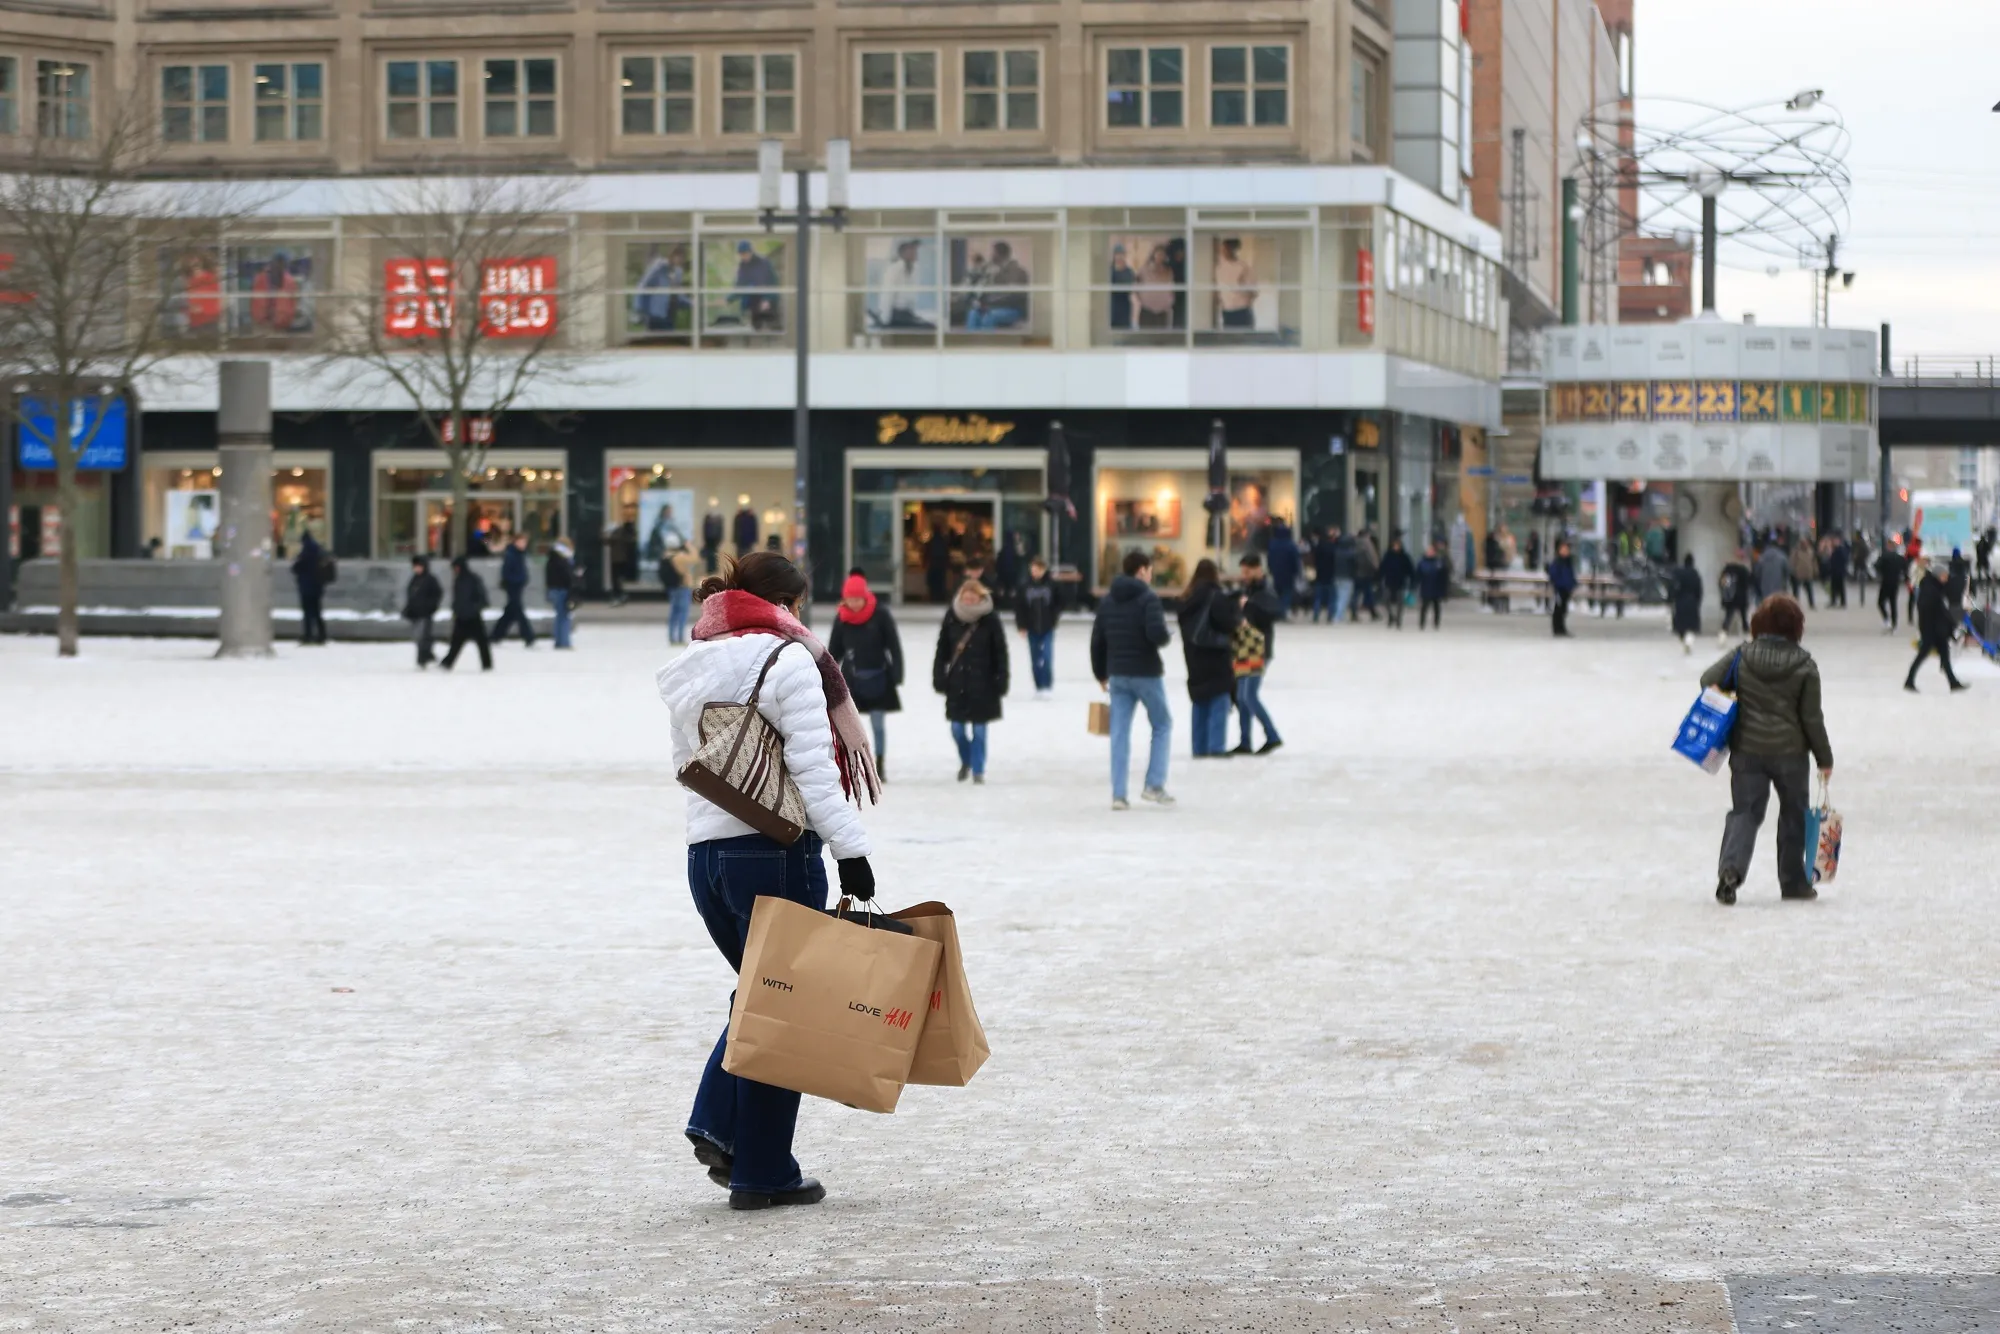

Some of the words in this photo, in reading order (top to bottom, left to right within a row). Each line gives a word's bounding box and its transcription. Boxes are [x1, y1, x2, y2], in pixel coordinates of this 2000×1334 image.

[487, 265, 543, 294] UNI
[487, 299, 549, 333] QLO
[1620, 384, 1647, 414] 21
[1656, 384, 1692, 414] 22
[1698, 384, 1734, 414] 23
[1742, 384, 1774, 414] 24
[1790, 385, 1802, 415] 1
[1822, 387, 1835, 416] 2
[762, 977, 794, 993] WITH
[848, 1001, 882, 1017] LOVE
[883, 1007, 913, 1031] H&M
